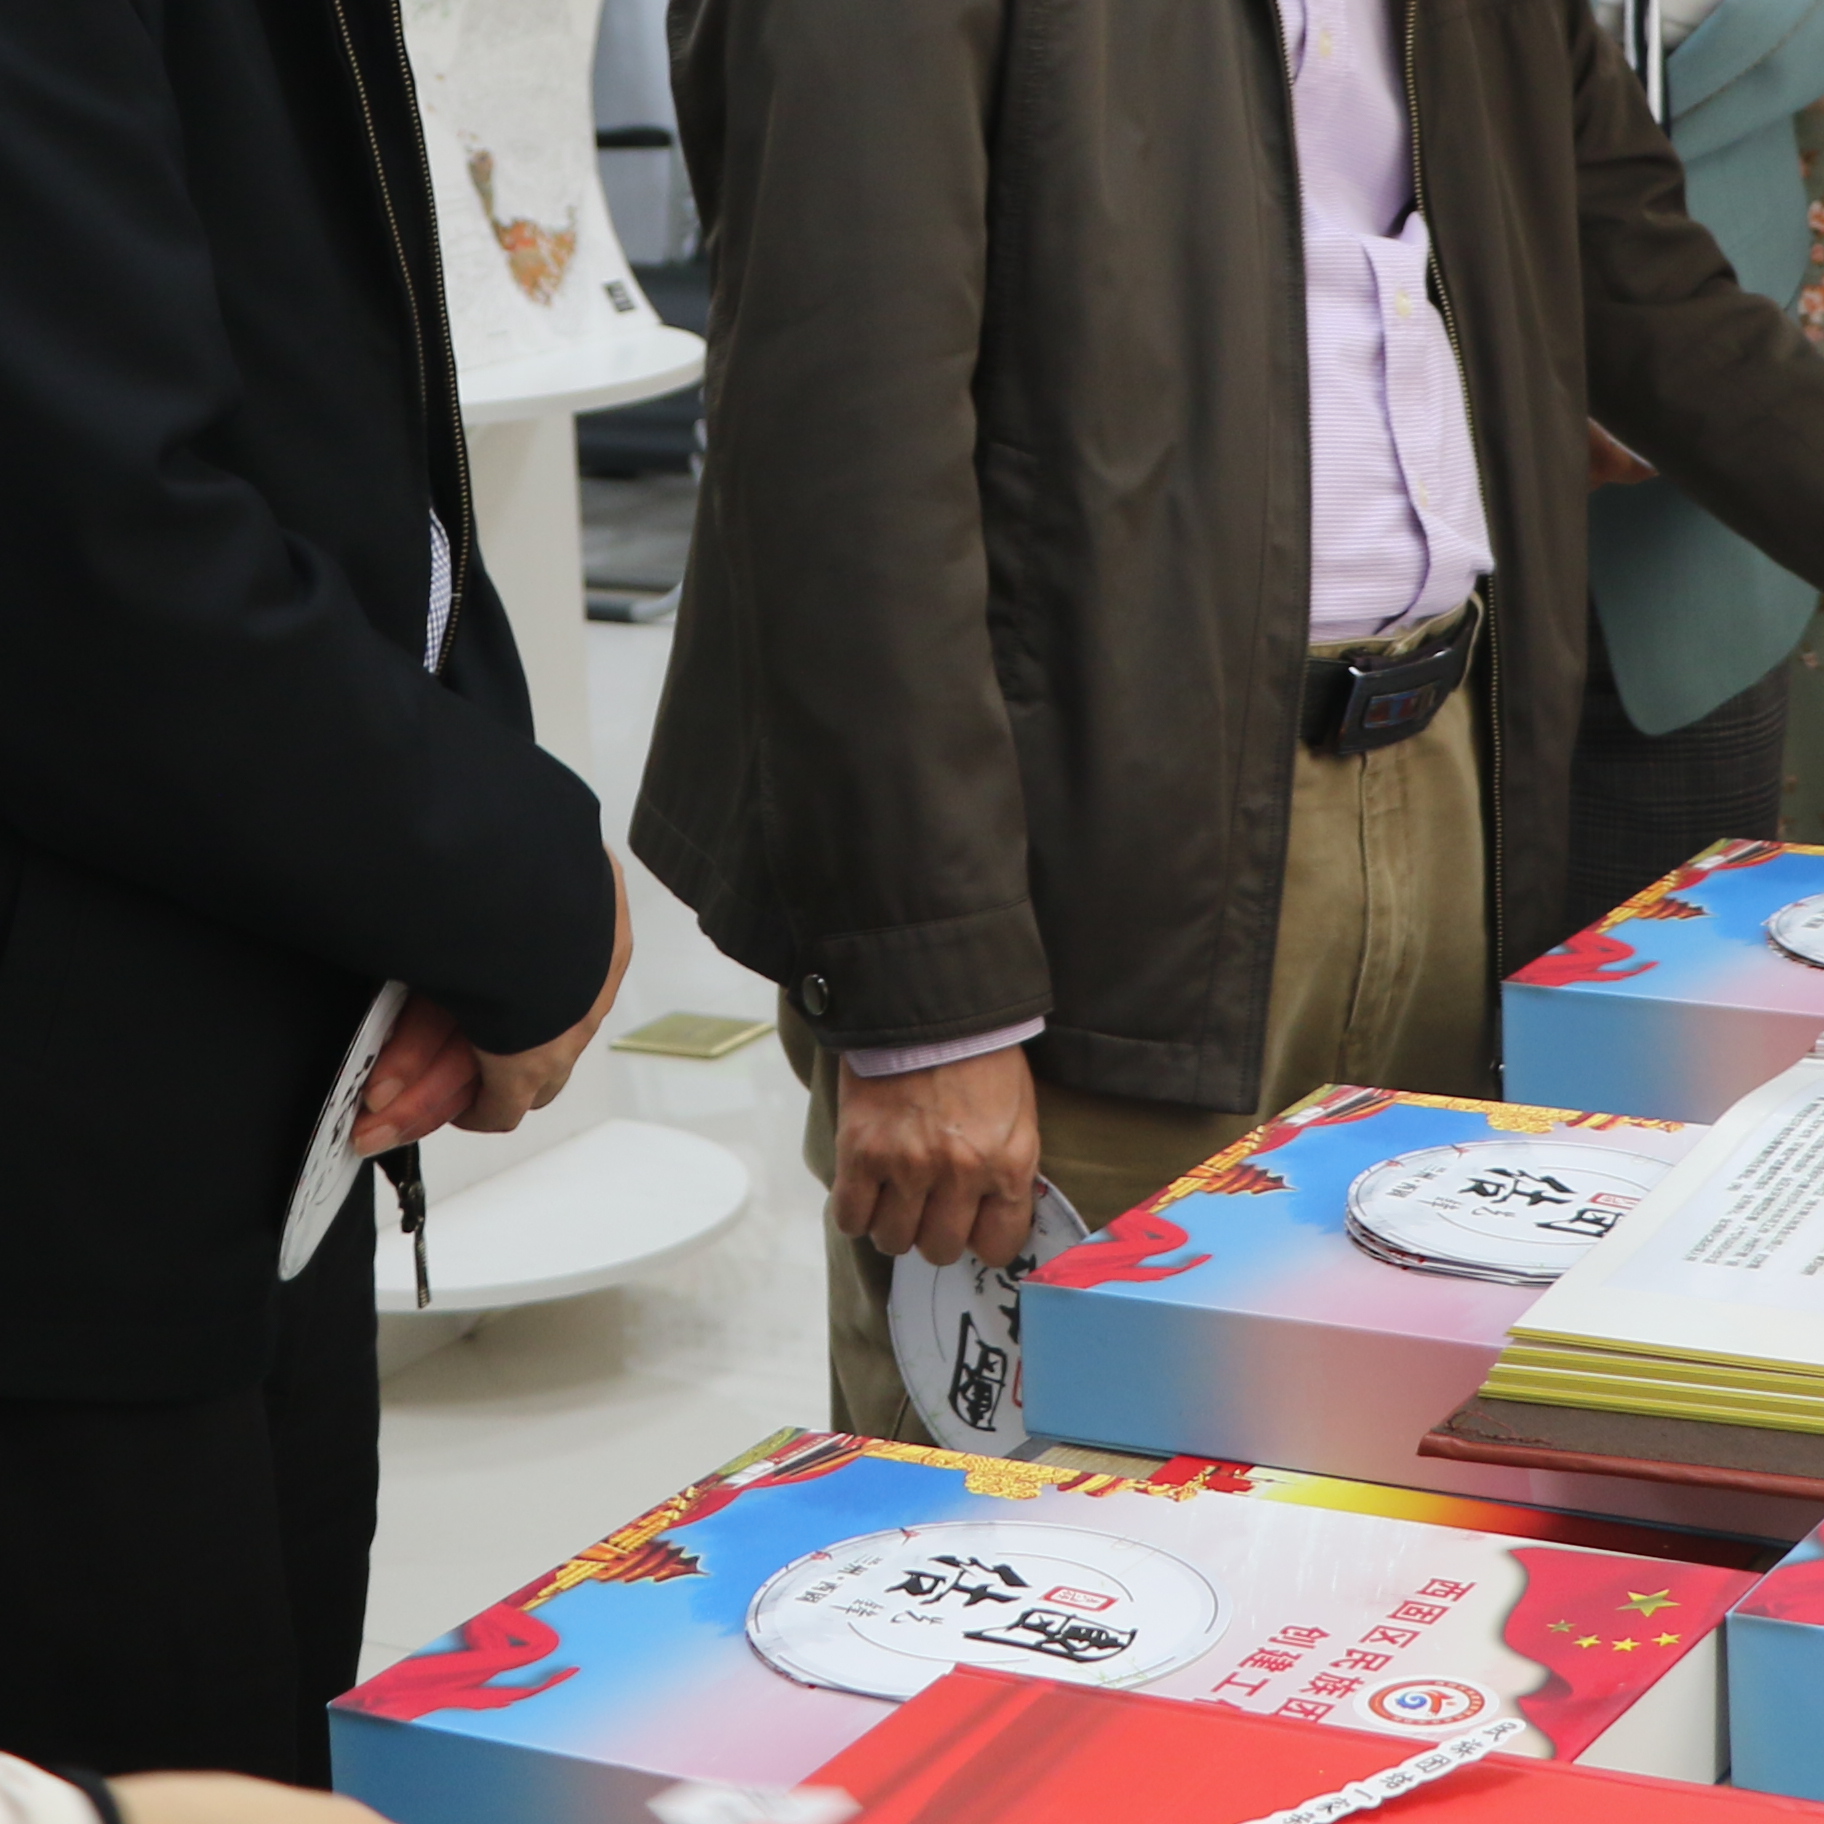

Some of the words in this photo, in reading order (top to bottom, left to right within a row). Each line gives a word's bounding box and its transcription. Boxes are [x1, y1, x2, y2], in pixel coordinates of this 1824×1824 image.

[1278, 1576, 1479, 1724] 西固区民族团
